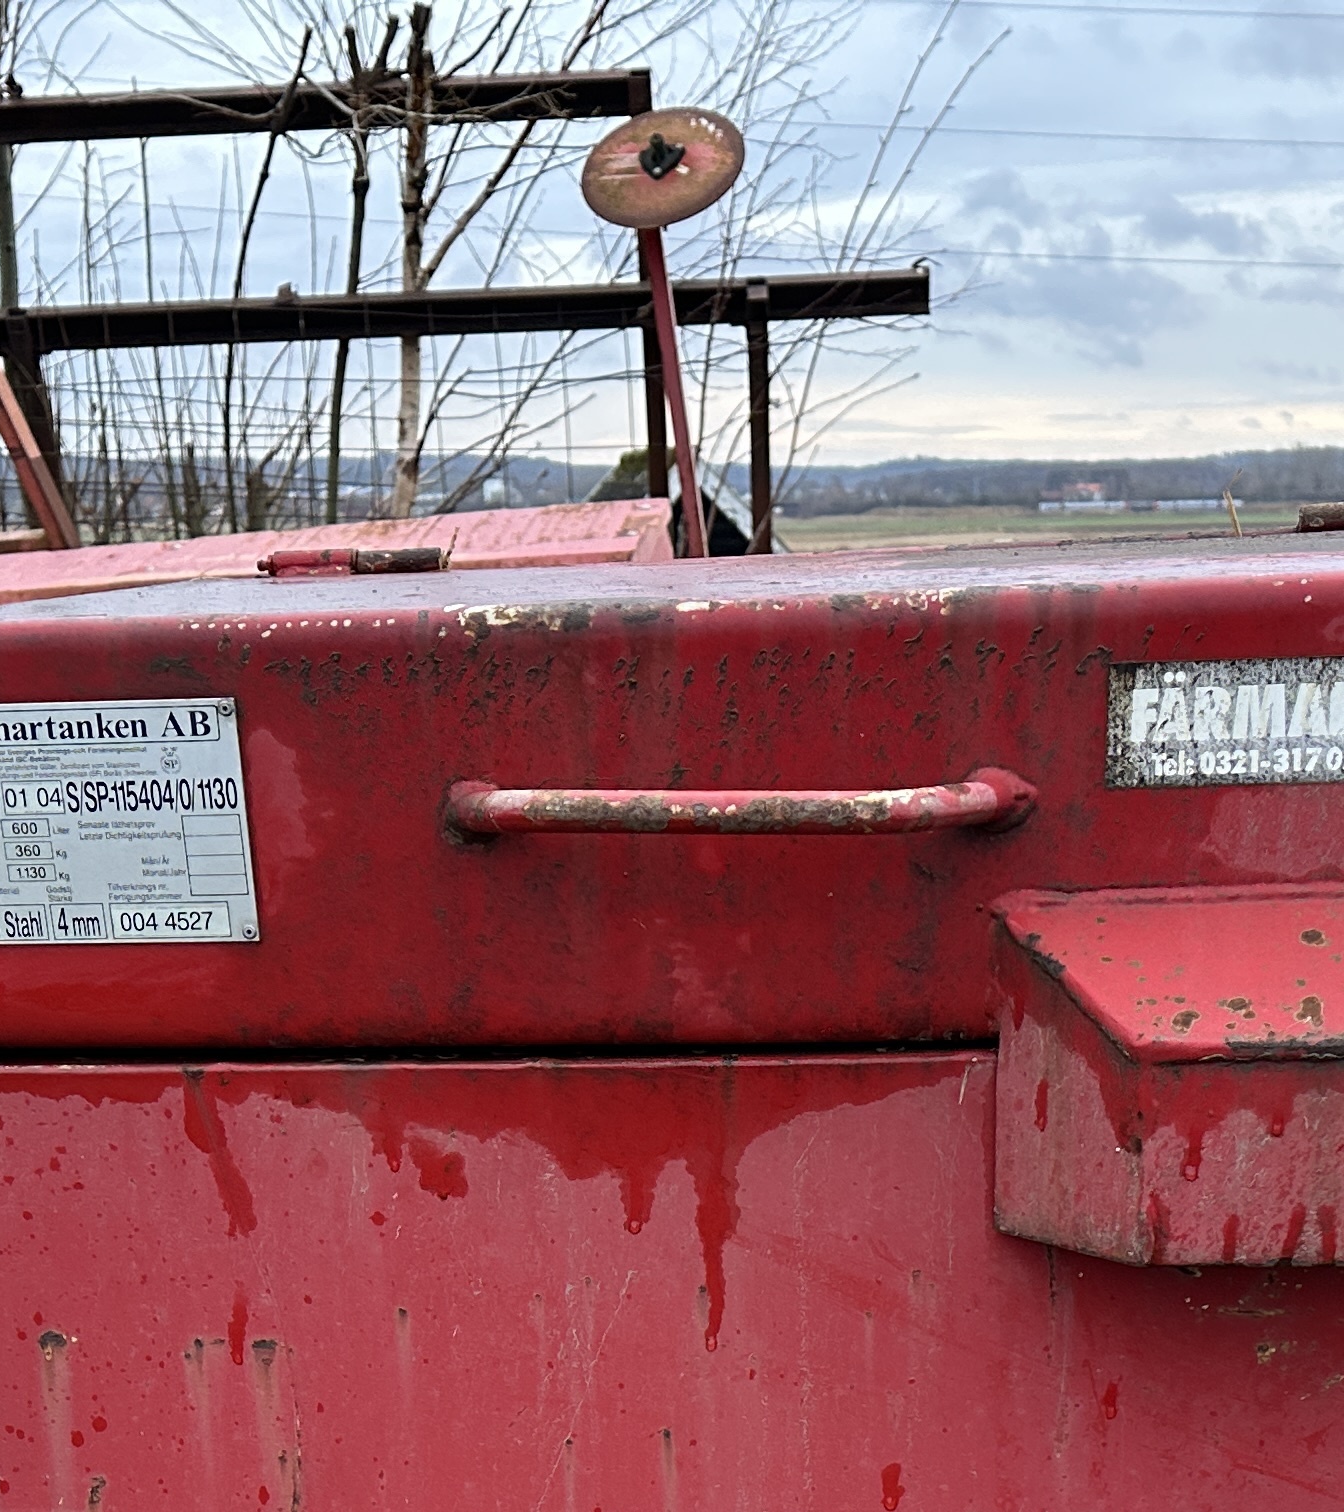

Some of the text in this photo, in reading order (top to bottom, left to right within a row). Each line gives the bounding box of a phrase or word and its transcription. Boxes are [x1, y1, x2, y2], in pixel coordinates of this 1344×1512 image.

[161, 710, 211, 738] AB
[37, 787, 63, 808] 04
[12, 822, 38, 835] 600
[15, 844, 41, 857] 360
[4, 911, 44, 938] Stahl
[58, 907, 69, 936] 4
[72, 916, 102, 937] mm
[119, 912, 158, 932] 004
[165, 911, 213, 931] 4527
